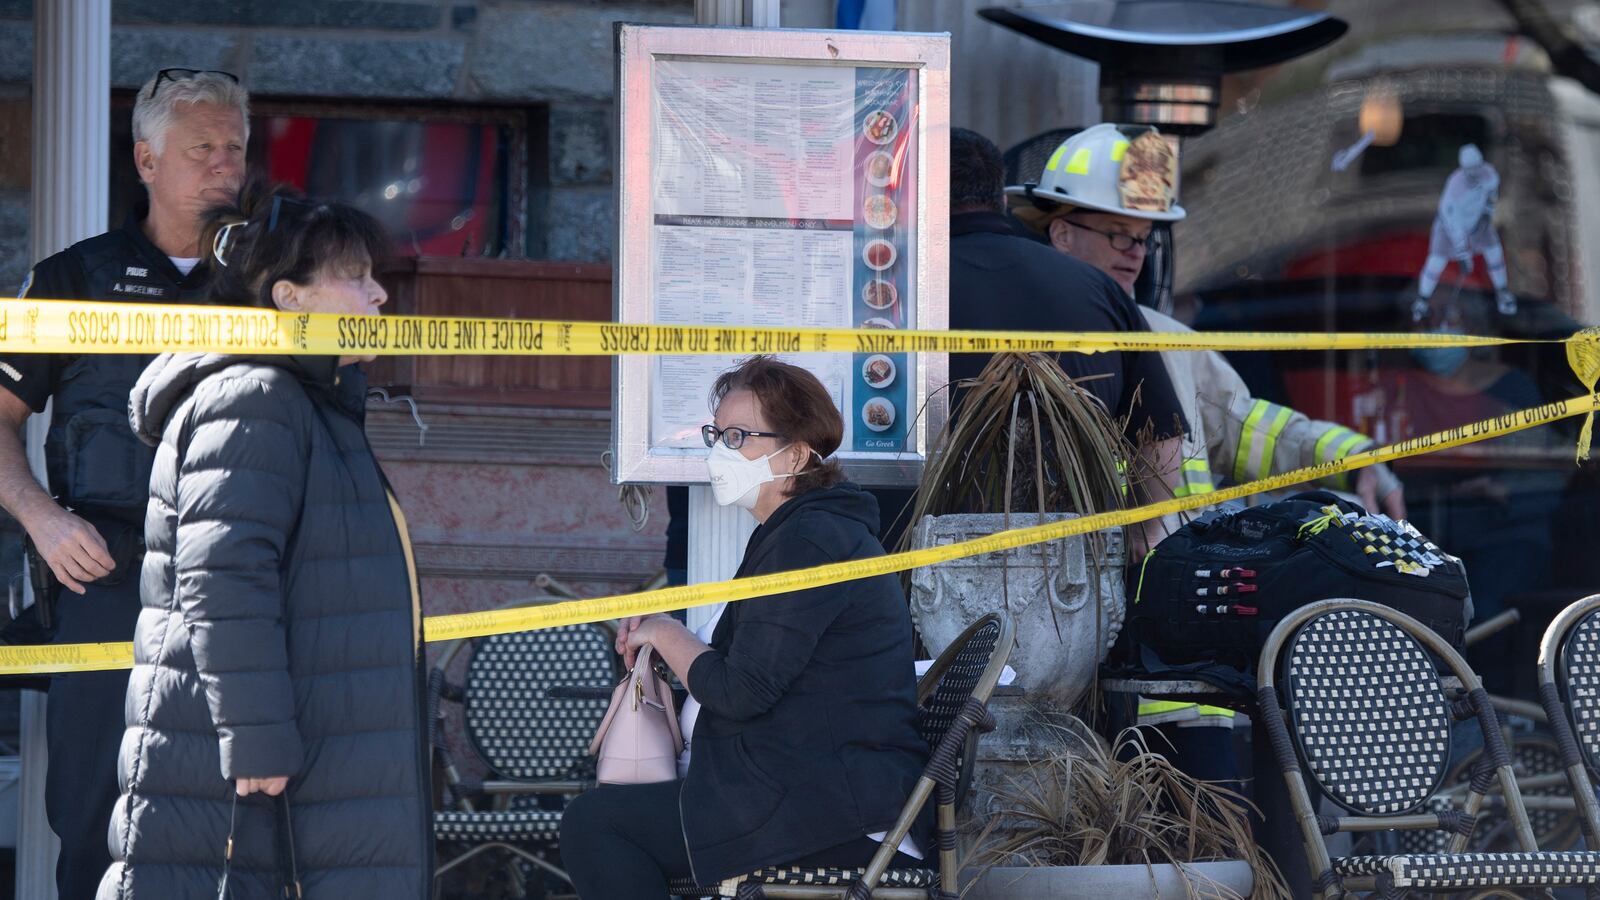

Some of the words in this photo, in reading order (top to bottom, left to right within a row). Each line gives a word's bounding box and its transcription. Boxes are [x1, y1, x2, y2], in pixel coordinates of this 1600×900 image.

[68, 310, 120, 345] CROSS
[125, 311, 156, 345] NOT
[161, 312, 182, 345] DO
[188, 313, 221, 346] LINE
[226, 313, 279, 347] POLICE
[337, 316, 387, 349] CROSS
[392, 318, 422, 349] NOT
[428, 319, 448, 349] DO
[454, 320, 486, 349] LINE
[491, 321, 543, 350] POLICE
[600, 324, 649, 352] CROSS
[655, 326, 683, 351] NOT
[865, 440, 875, 448] Go
[876, 440, 895, 448] Greek
